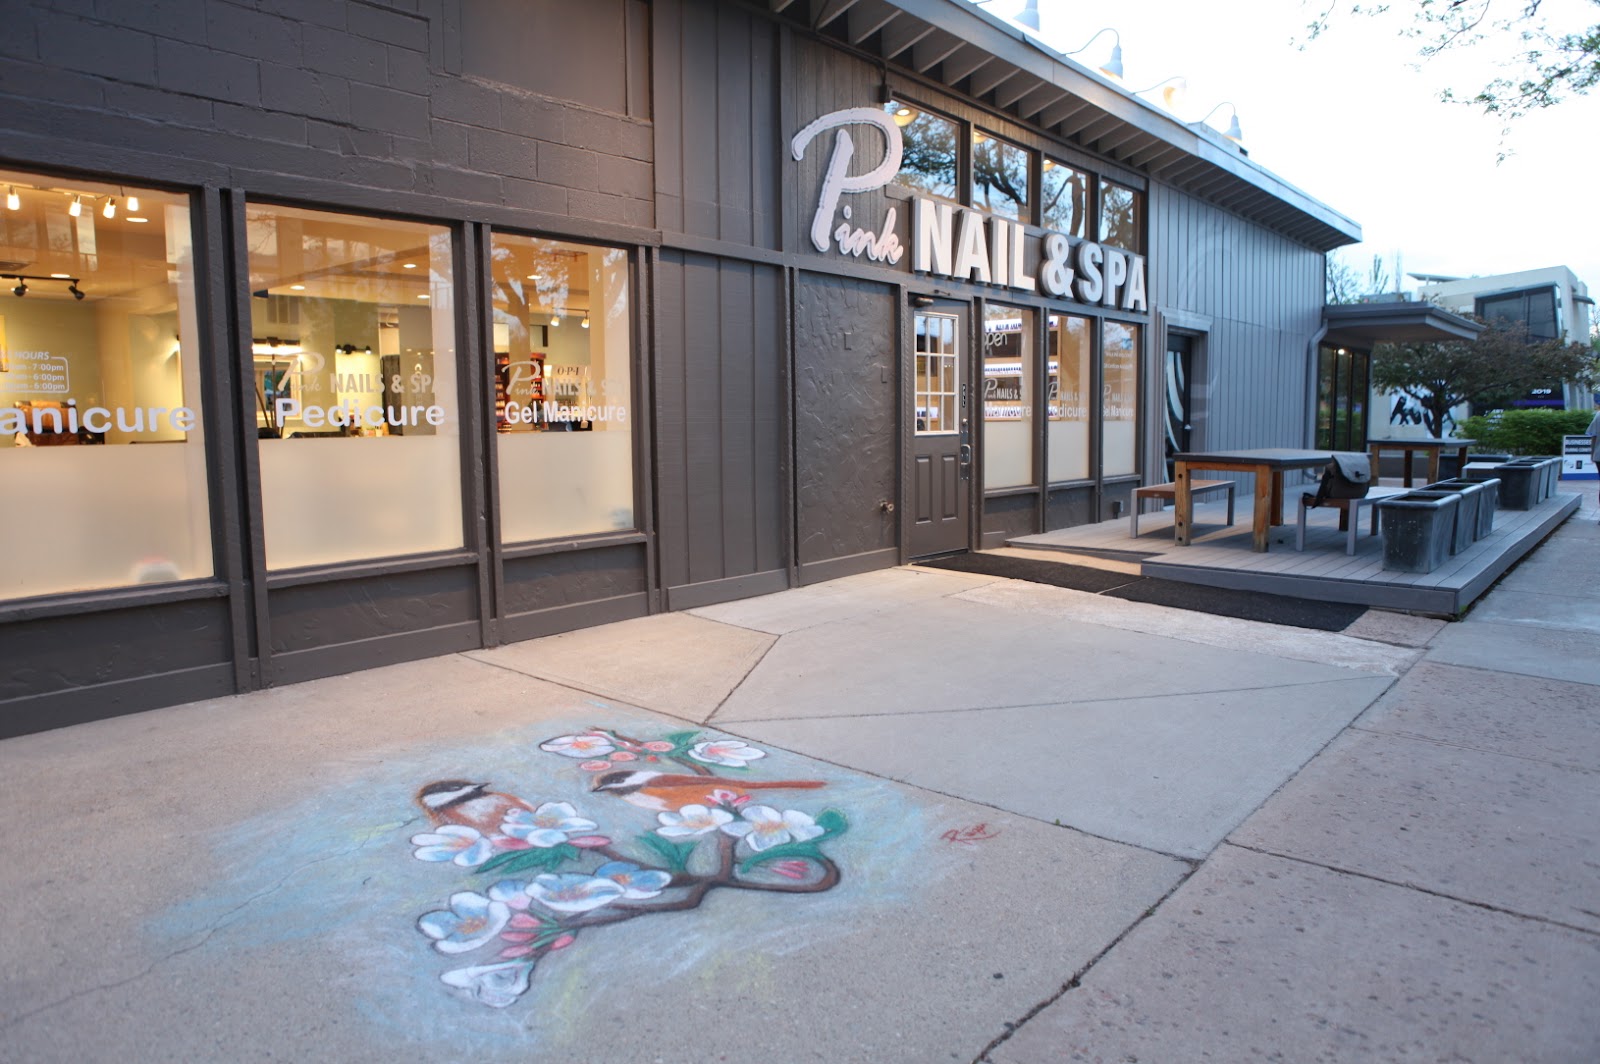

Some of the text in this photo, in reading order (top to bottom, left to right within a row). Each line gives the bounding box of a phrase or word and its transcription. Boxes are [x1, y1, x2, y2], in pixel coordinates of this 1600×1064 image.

[791, 107, 1149, 312] Pink NAIL & SPA
[984, 332, 1008, 350] pen
[330, 373, 385, 394] NAILS
[391, 374, 405, 393] &
[275, 398, 446, 428] Pedicure
[504, 400, 627, 424] Gel Manicure
